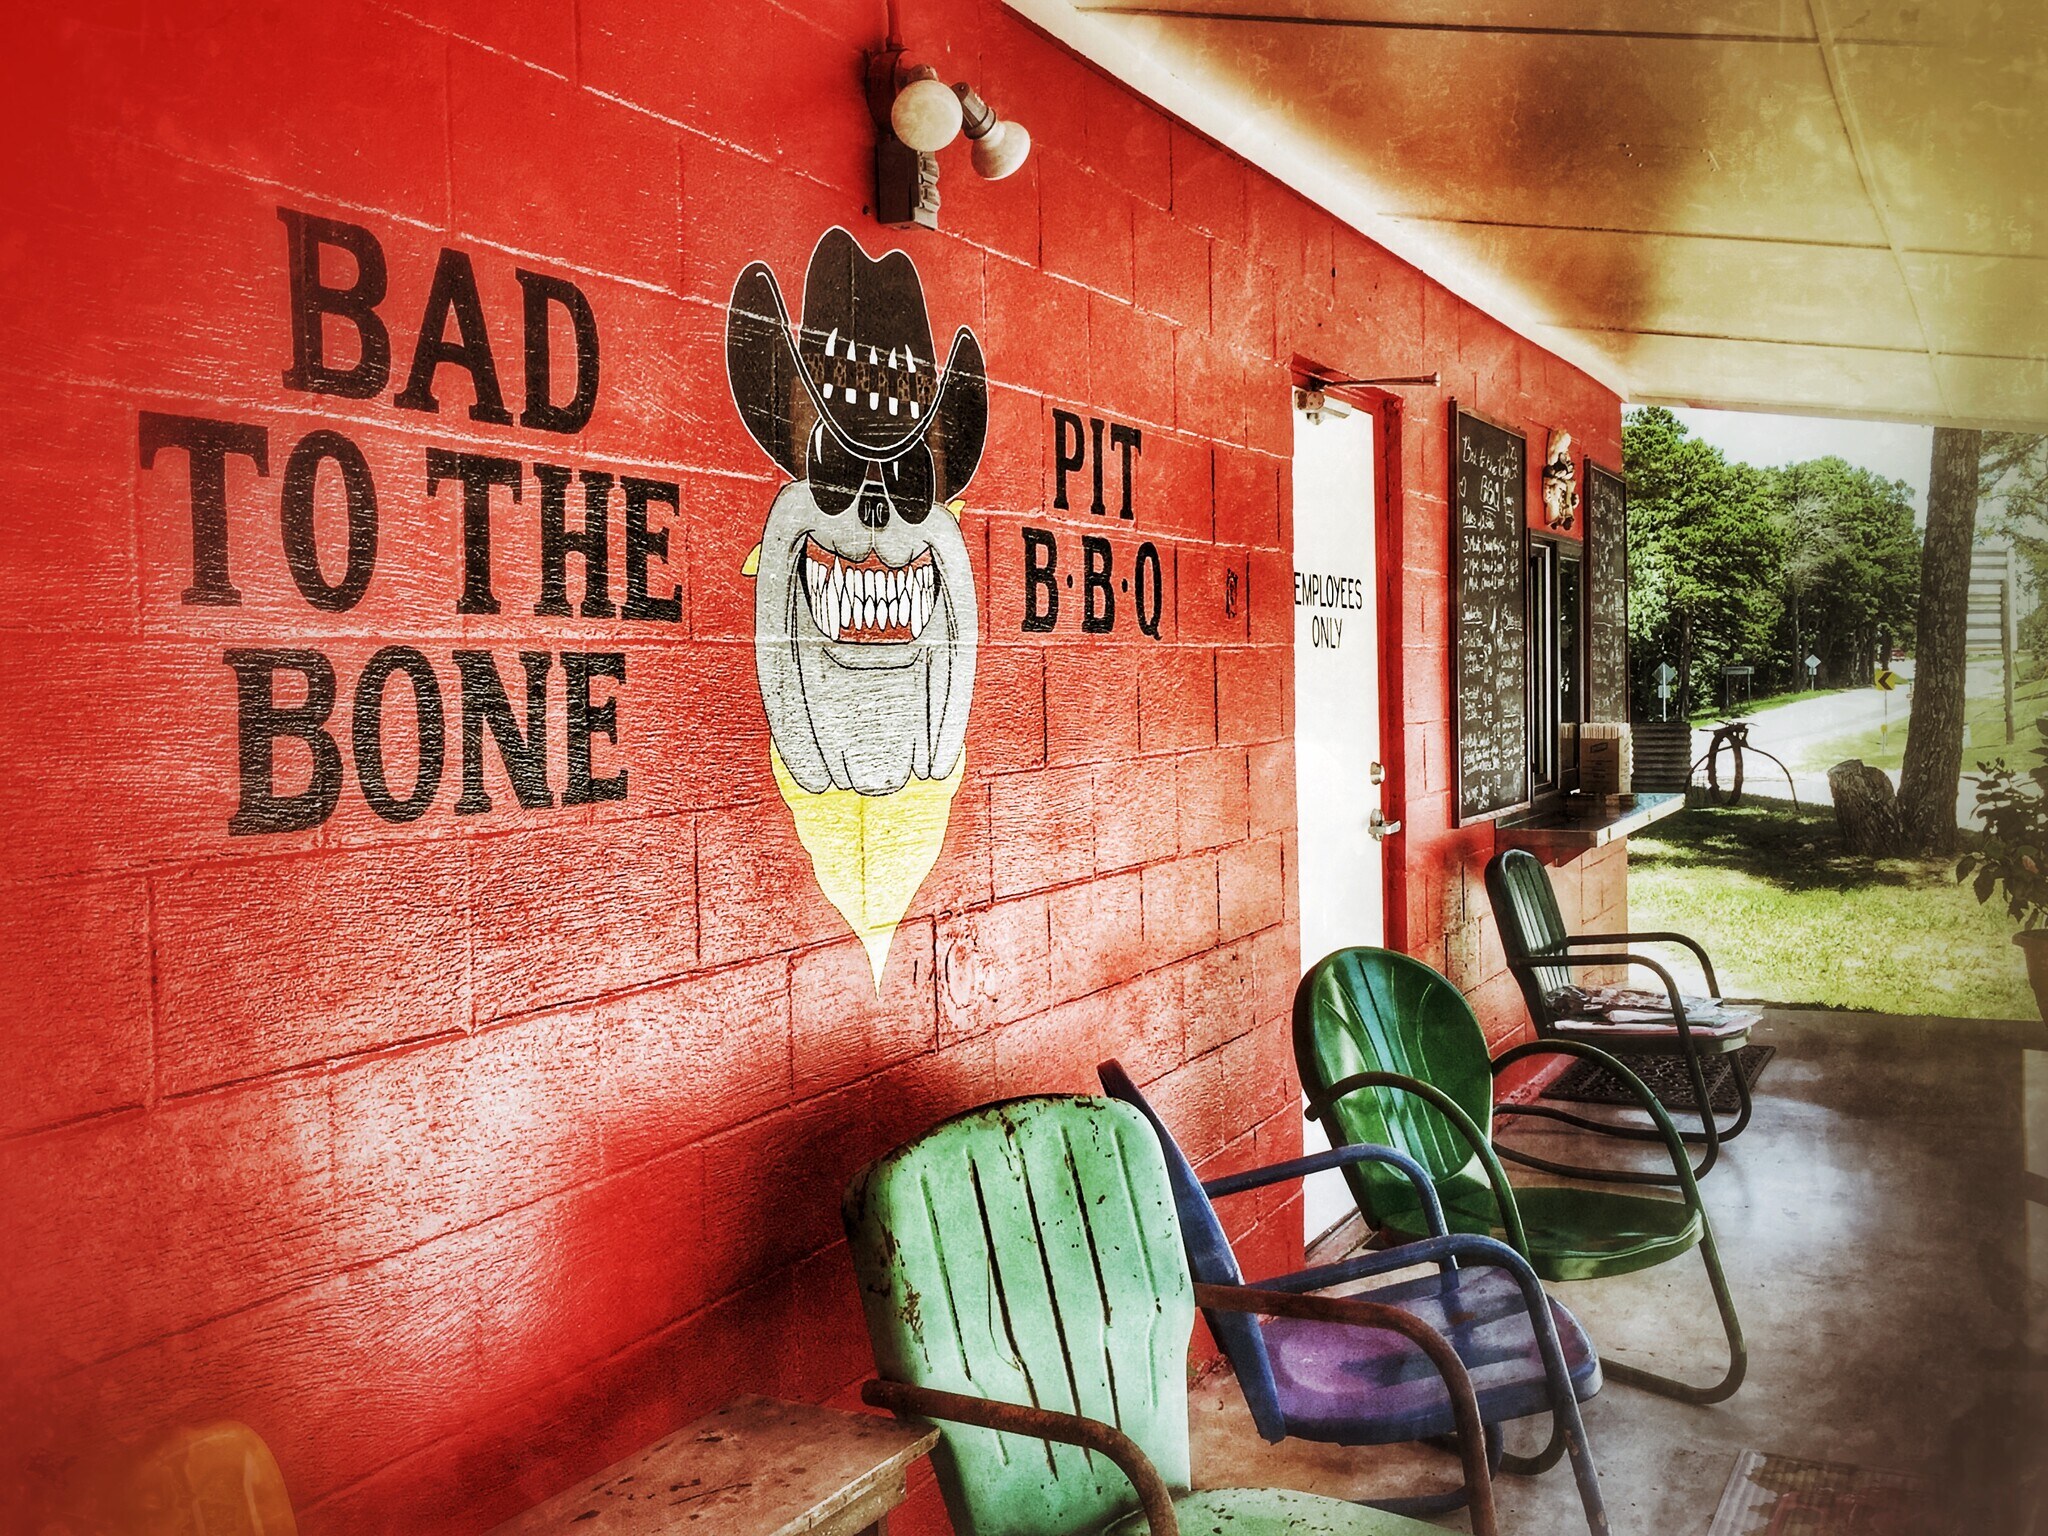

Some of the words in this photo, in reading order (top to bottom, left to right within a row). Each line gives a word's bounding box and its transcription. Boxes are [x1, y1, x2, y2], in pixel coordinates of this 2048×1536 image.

[276, 205, 600, 434] BAD
[139, 410, 379, 613] TO
[425, 447, 684, 623] THE
[1052, 408, 1141, 520] PIT
[1294, 572, 1363, 610] EMPLOYEES
[1312, 615, 1343, 649] ONLY
[222, 645, 628, 837] BONE
